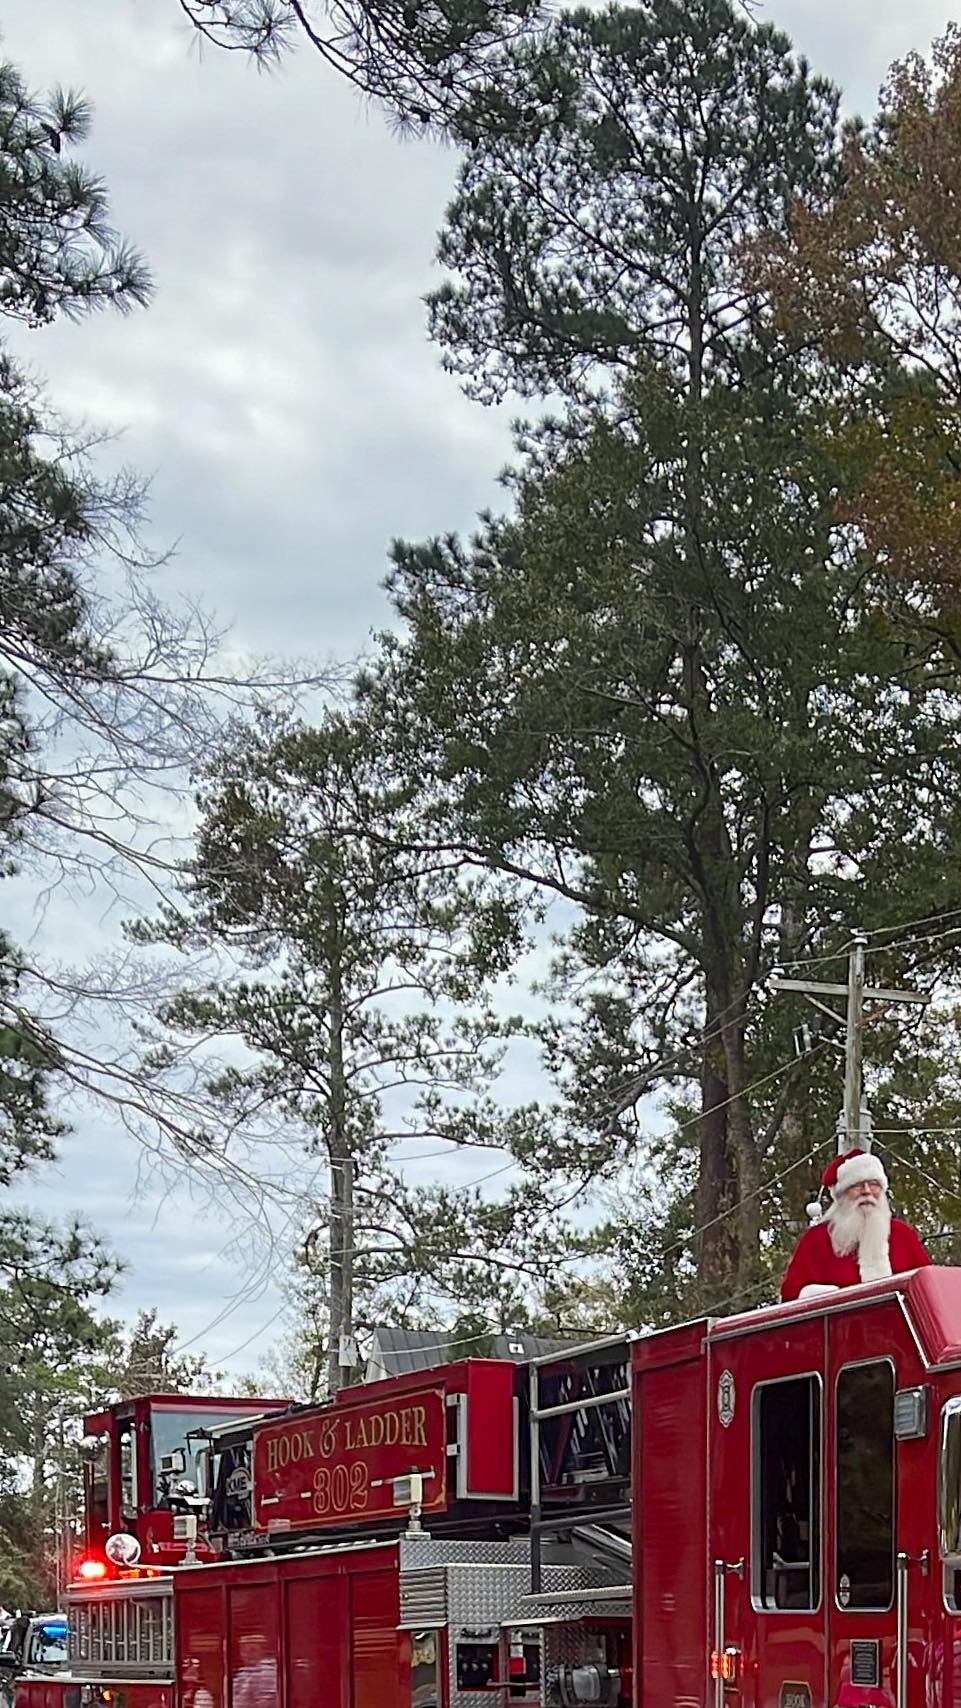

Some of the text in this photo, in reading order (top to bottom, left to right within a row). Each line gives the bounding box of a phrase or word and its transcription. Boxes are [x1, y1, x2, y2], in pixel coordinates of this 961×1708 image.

[267, 1406, 428, 1472] HOOK & LADDER
[313, 1461, 369, 1514] 302
